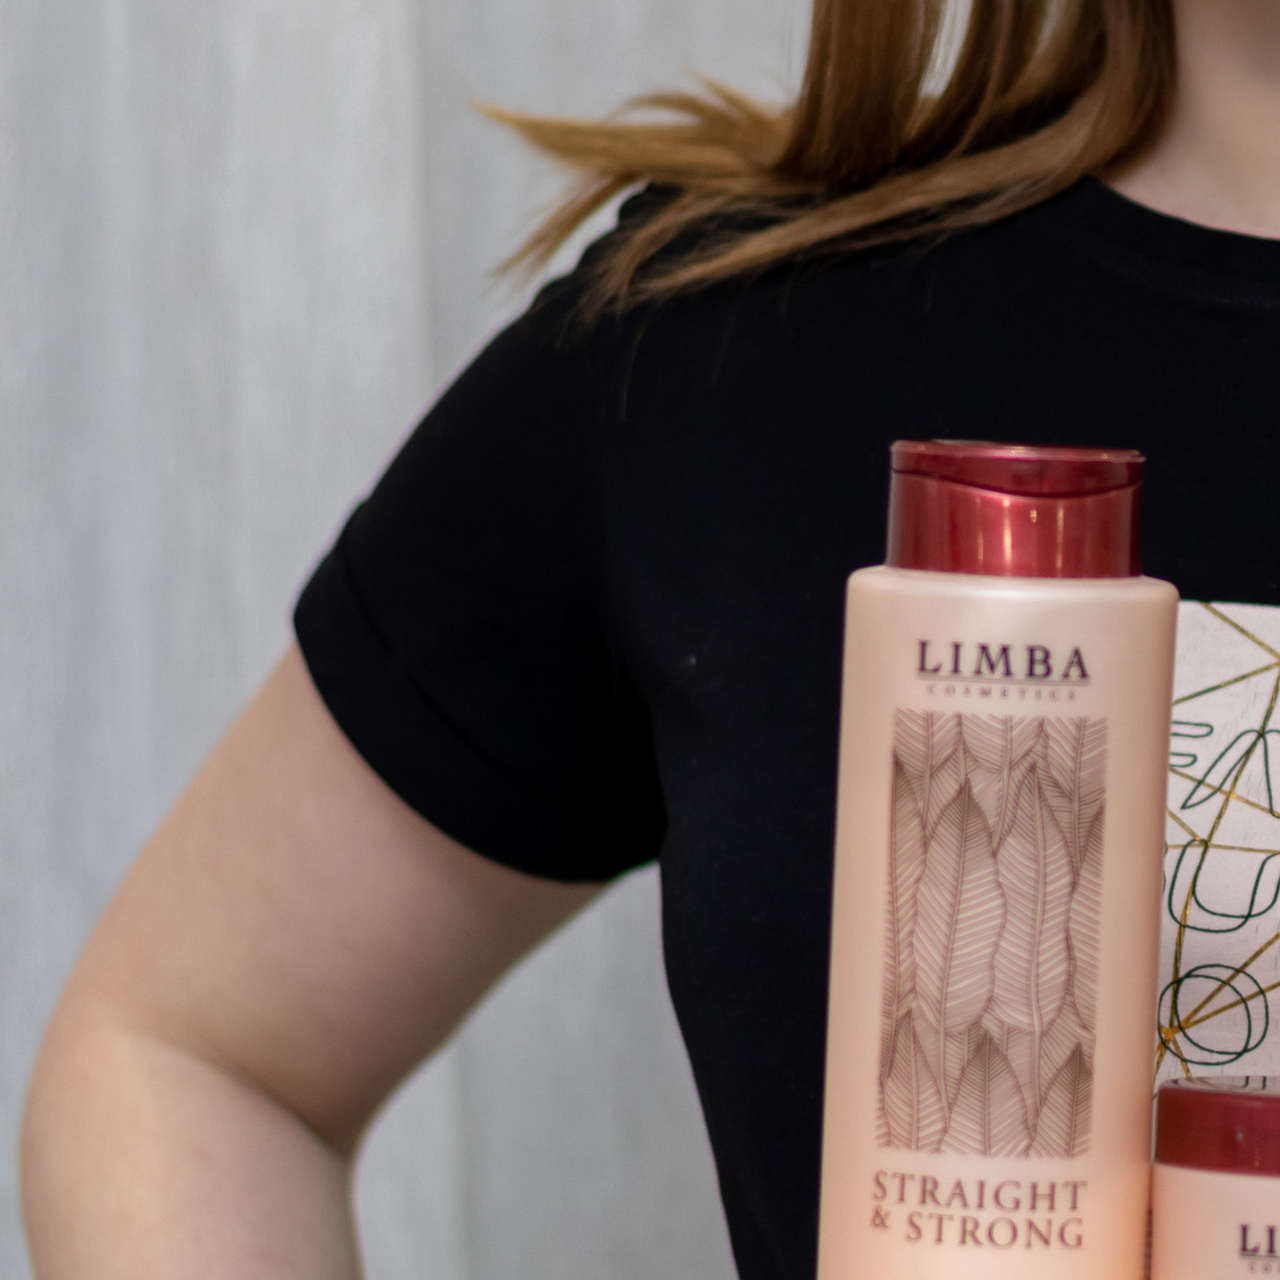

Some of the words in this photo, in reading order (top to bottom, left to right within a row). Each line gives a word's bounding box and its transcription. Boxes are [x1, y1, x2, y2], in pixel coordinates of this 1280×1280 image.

[916, 639, 1089, 680] LIMBA
[926, 684, 1077, 702] COSMETICS
[872, 1169, 1088, 1212] STRAIGHT
[870, 1204, 890, 1230] &
[905, 1210, 1084, 1250] STRONG
